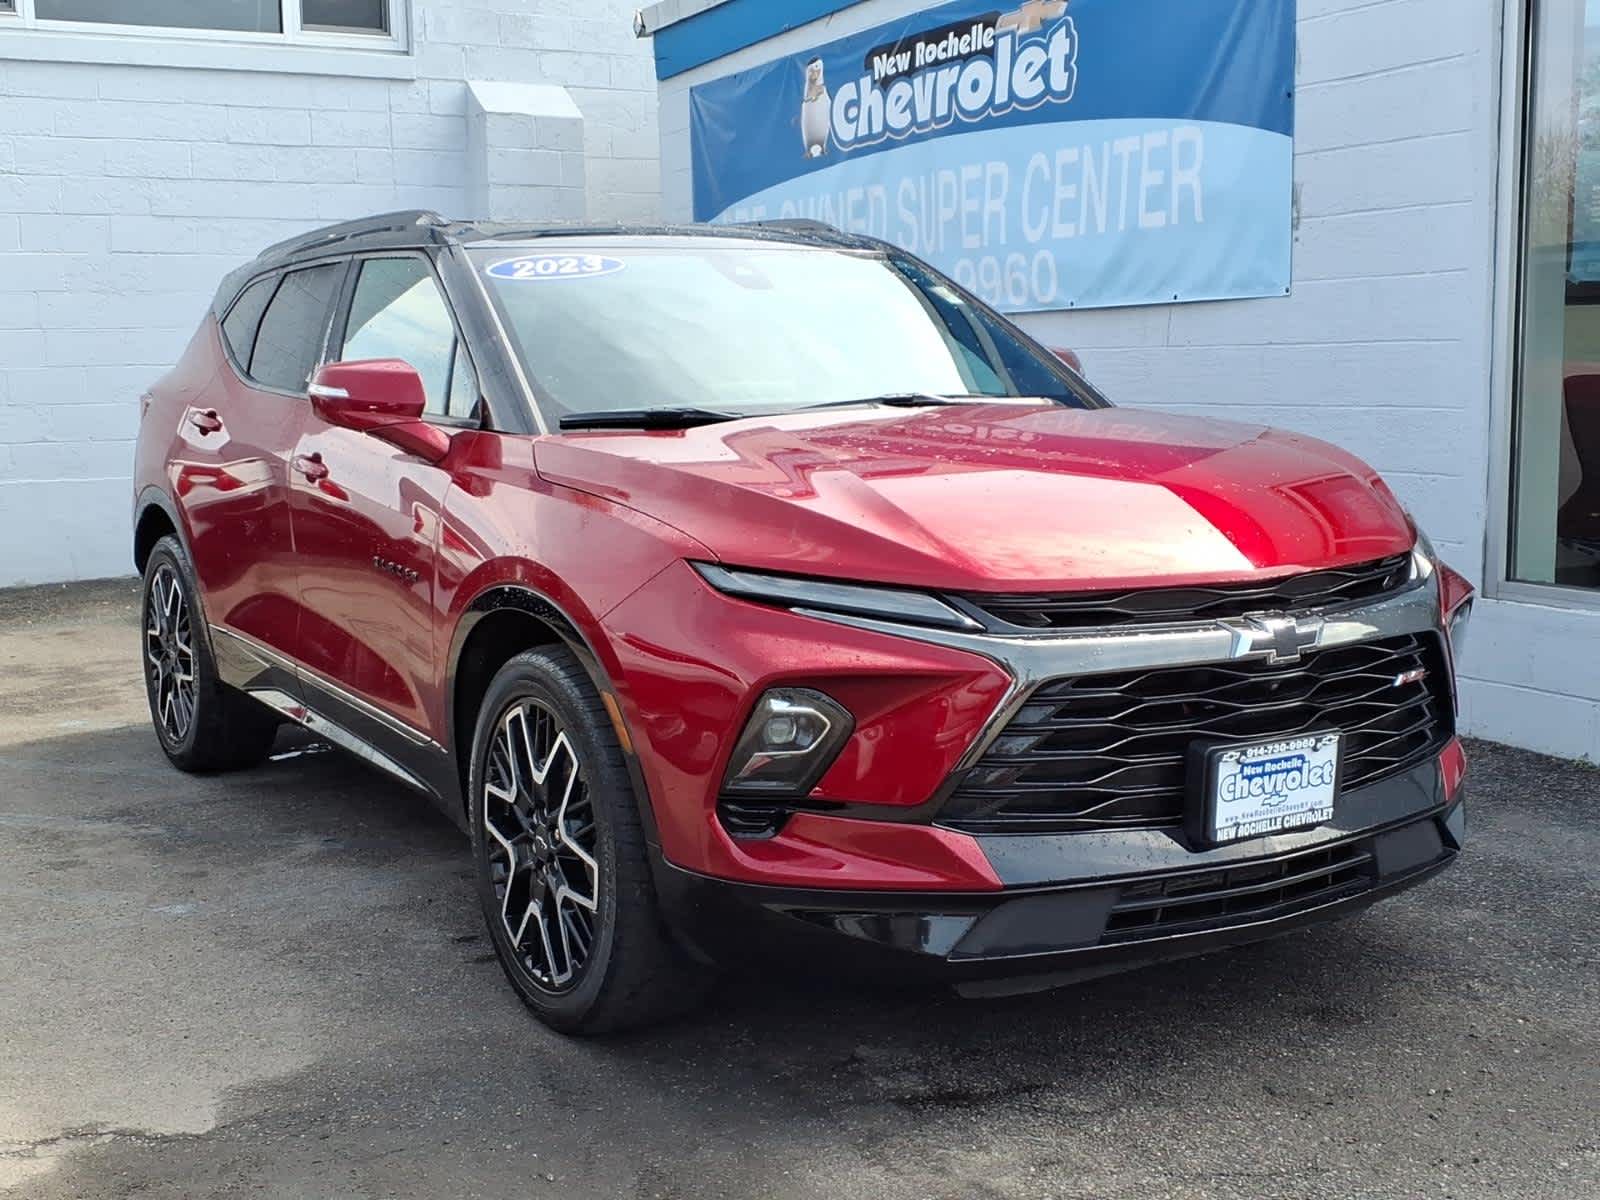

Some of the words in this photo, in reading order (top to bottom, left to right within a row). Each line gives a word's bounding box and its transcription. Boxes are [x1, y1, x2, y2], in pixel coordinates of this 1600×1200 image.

[872, 51, 912, 81] New
[915, 23, 995, 66] Rochelle
[830, 23, 1072, 143] Chevrolet
[897, 161, 1009, 256] SUPER
[1021, 126, 1204, 244] CENTER
[512, 255, 604, 277] 2023
[1220, 760, 1333, 802] Chevrolet
[1243, 763, 1263, 776] New
[1264, 757, 1303, 772] Rochelle
[1216, 825, 1239, 842] NEW
